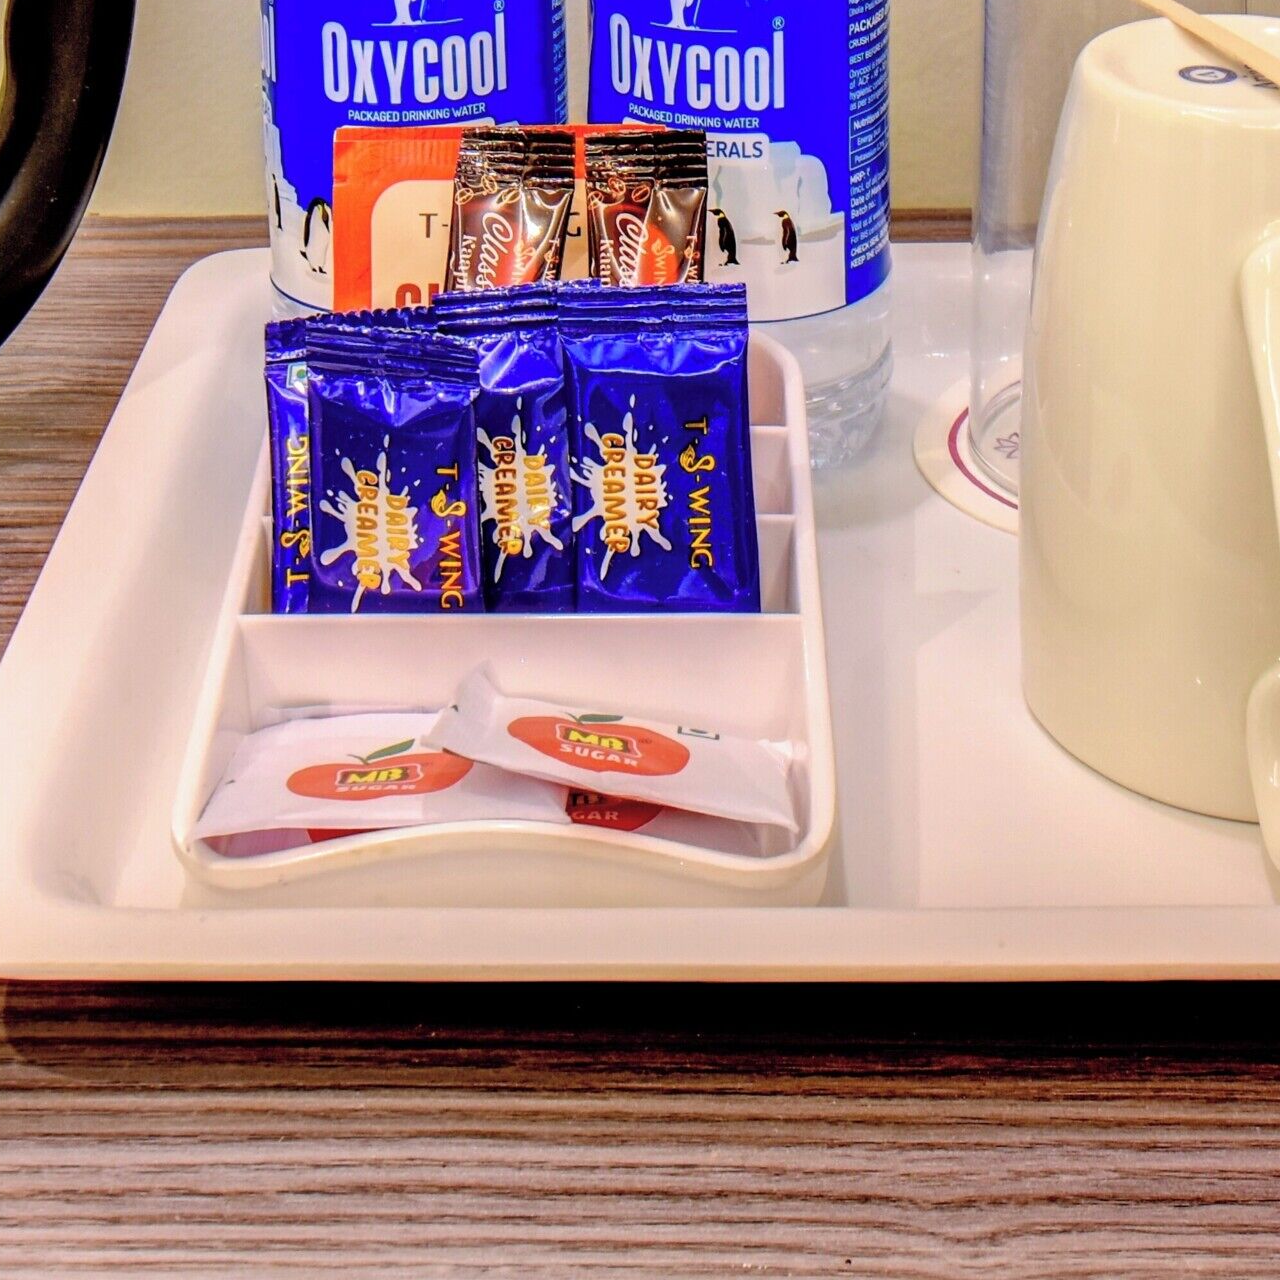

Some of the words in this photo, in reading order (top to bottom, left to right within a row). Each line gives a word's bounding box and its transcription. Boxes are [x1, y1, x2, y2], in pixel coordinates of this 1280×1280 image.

[347, 109, 400, 123] PACKAGED
[402, 107, 450, 122] DRINKING
[451, 102, 486, 118] WATER
[628, 103, 673, 123] PACKAGED
[674, 113, 721, 129] DRINKING
[723, 117, 760, 129] WATER
[706, 140, 764, 158] ERALS
[851, 195, 864, 207] Date
[475, 212, 515, 290] Class
[491, 436, 523, 556] CREAMER
[523, 455, 551, 529] DAIRY
[601, 433, 631, 554] CREAMER
[633, 454, 660, 529] DAIRY
[679, 417, 716, 569] T-S-WING
[356, 470, 382, 590] CREAMER
[385, 494, 411, 571] DAIRY
[430, 462, 468, 609] T-S-WING
[335, 783, 417, 793] SUGAR
[345, 767, 404, 785] MB
[559, 743, 639, 767] SUGAR
[571, 810, 619, 821] GAR
